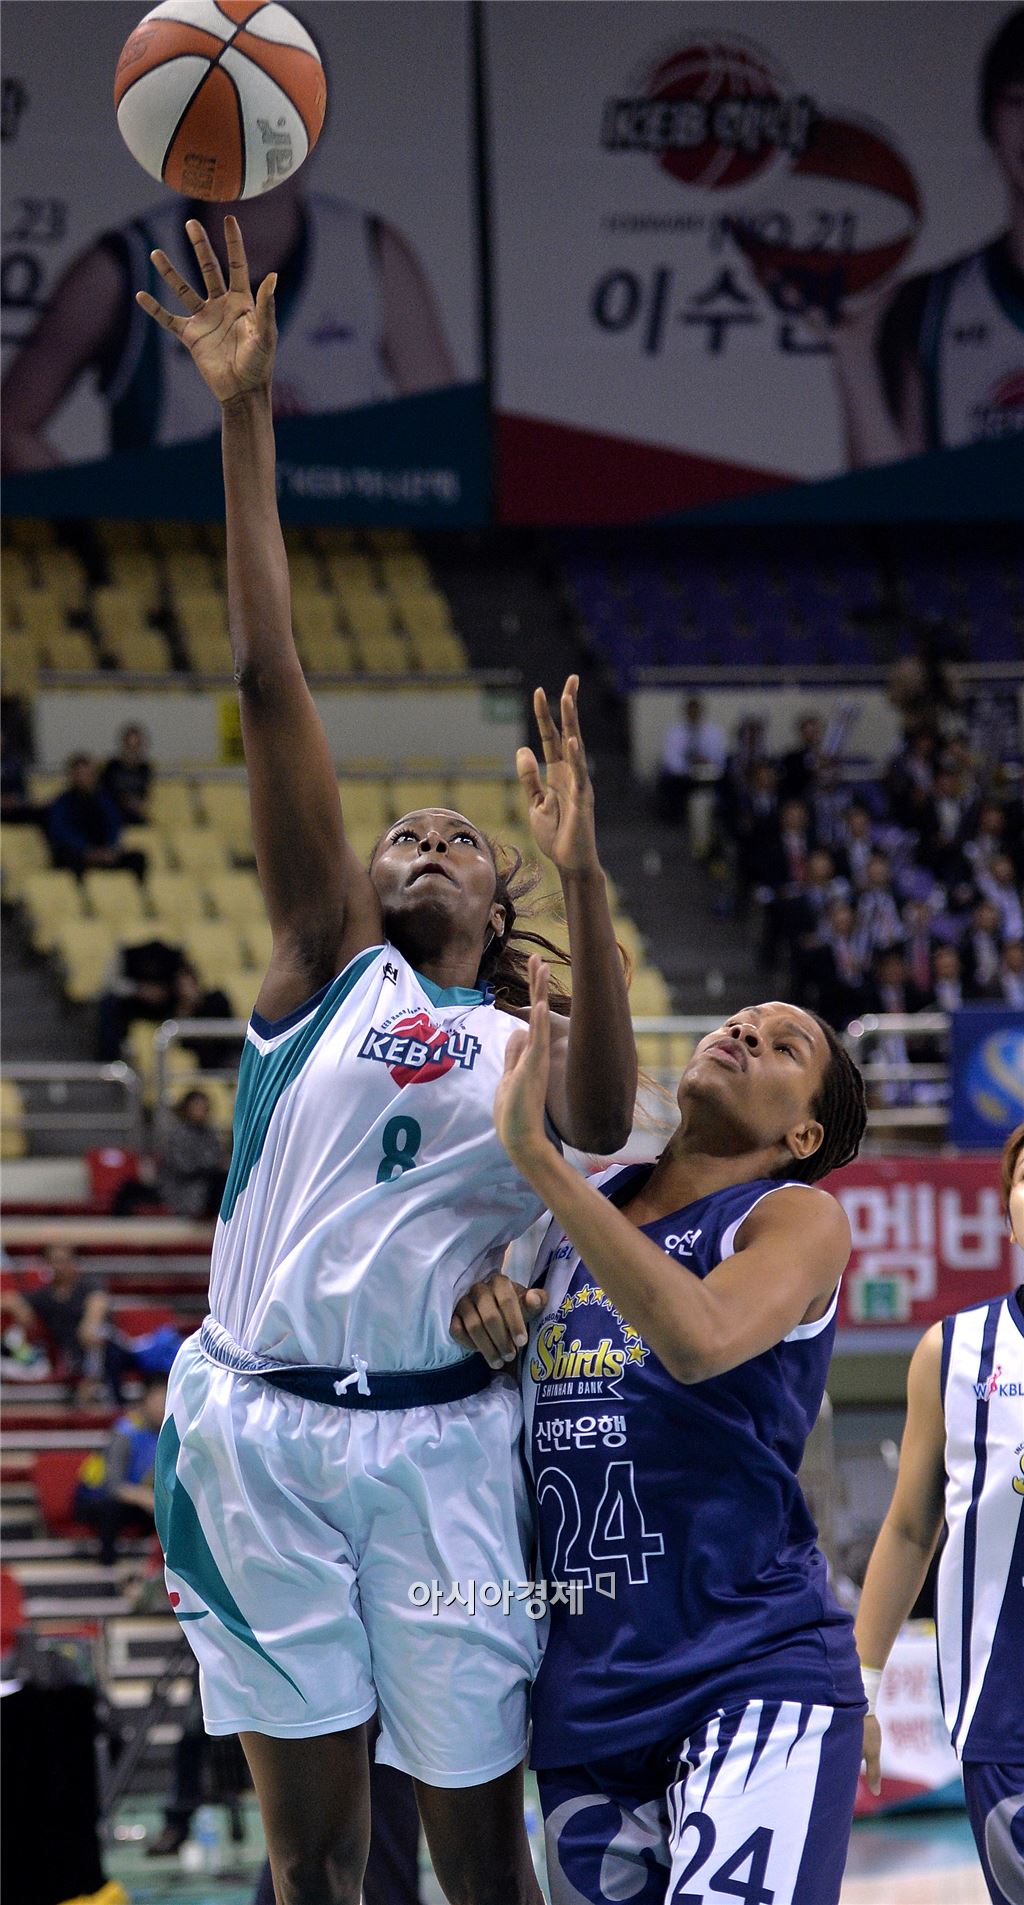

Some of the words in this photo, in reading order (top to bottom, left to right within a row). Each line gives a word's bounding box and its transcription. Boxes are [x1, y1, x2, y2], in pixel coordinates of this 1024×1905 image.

[375, 1115, 422, 1184] 8
[541, 1382, 573, 1398] SHINHAN
[577, 1380, 603, 1395] BANK
[535, 1415, 627, 1452] 신한은행
[537, 1460, 664, 1589] 24
[672, 1811, 776, 1905] 24
